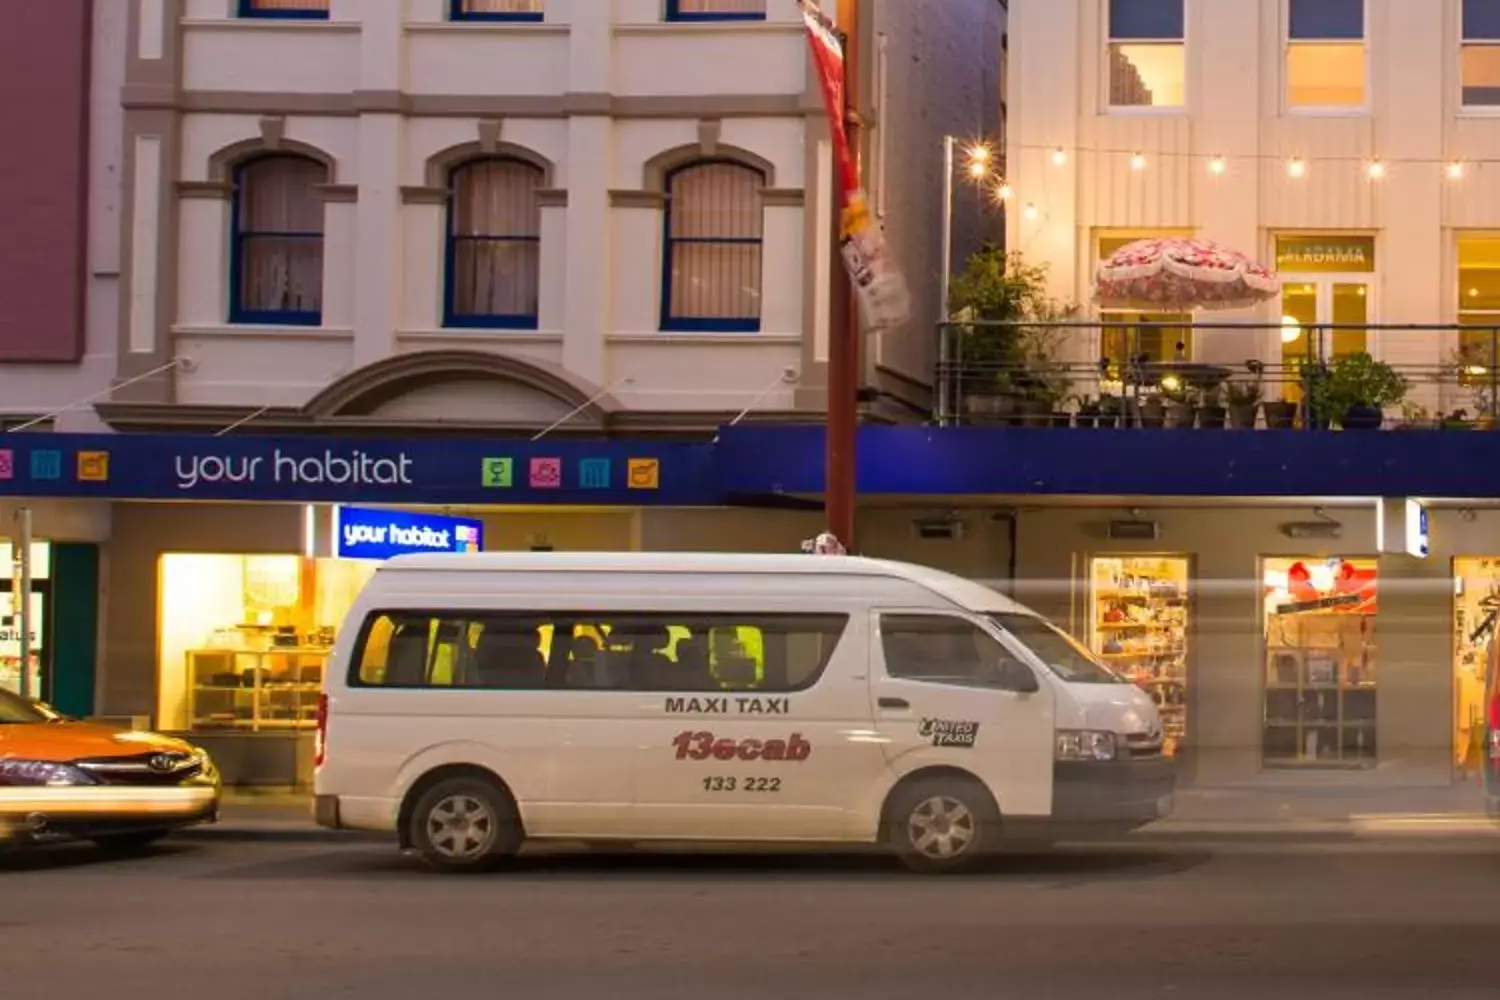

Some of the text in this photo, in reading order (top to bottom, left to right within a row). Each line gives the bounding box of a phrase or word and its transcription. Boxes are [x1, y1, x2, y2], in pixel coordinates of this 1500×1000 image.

[175, 449, 412, 488] your habitat
[343, 523, 450, 548] your habitat
[665, 697, 789, 714] MAXI TAXI
[703, 776, 781, 792] 133 222
